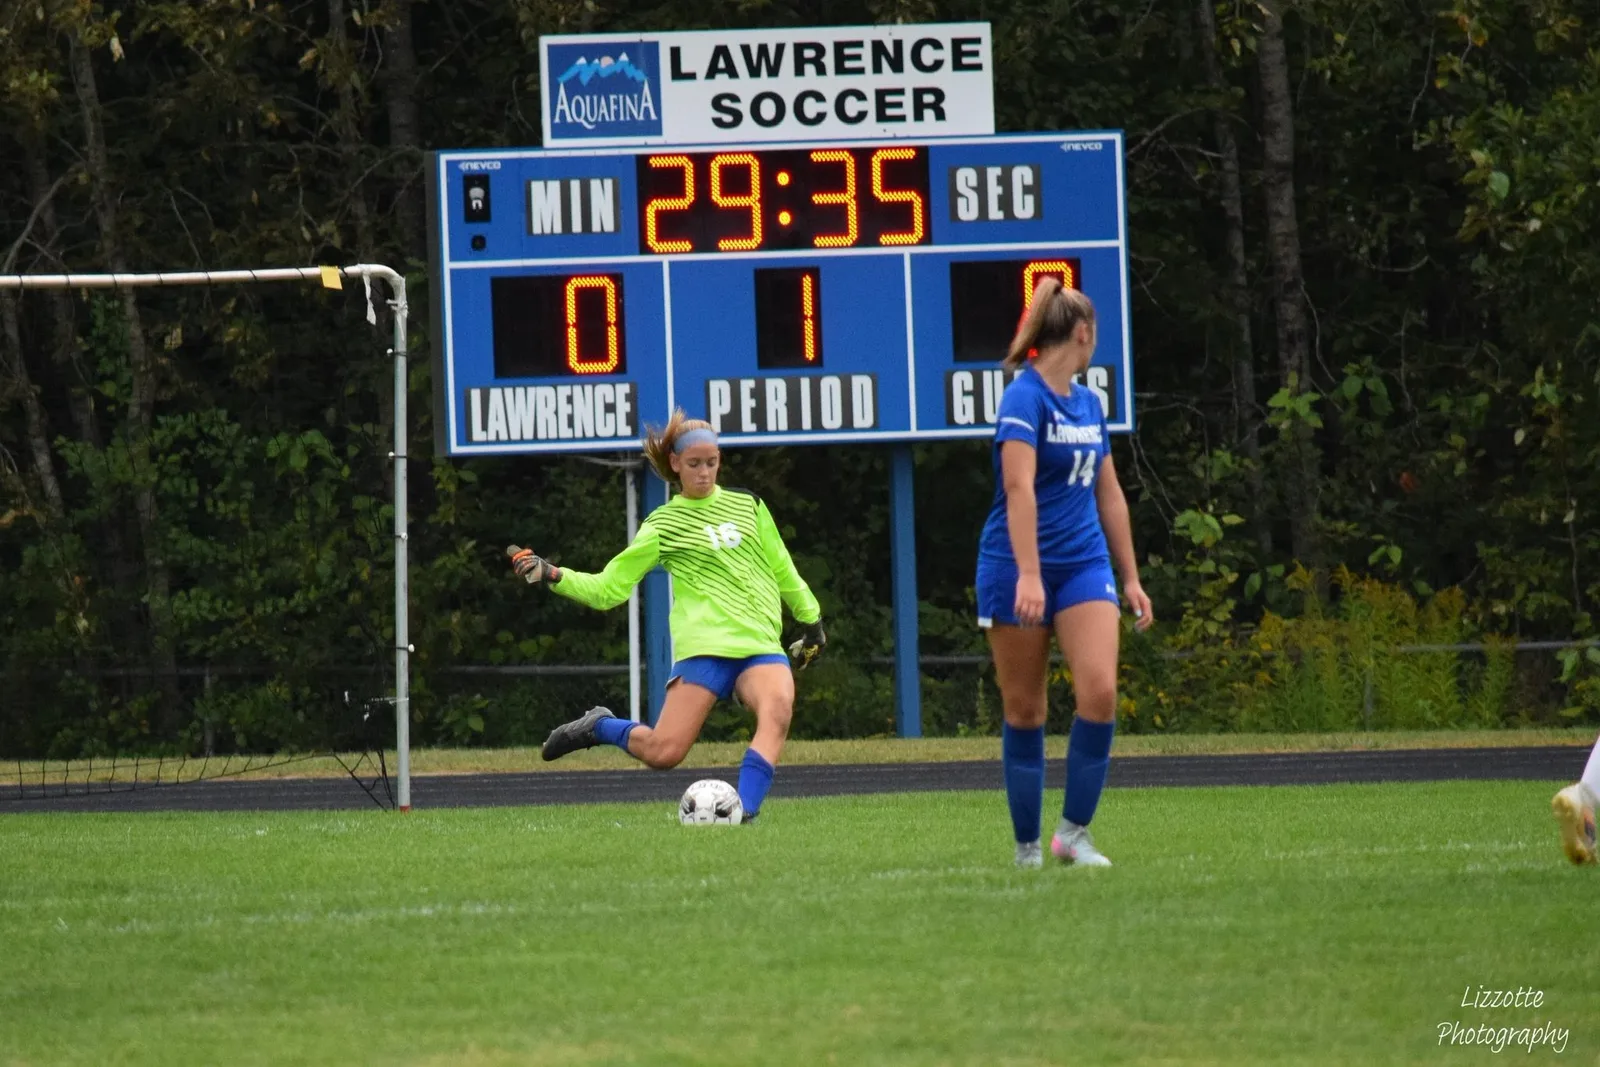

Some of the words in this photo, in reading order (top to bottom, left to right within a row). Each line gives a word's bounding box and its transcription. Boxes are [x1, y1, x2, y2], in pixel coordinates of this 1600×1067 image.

[669, 36, 983, 81] LAWRENCE
[553, 78, 658, 130] AQUAFINA
[710, 86, 946, 130] SOCCER
[530, 177, 615, 235] MIN
[646, 147, 924, 254] 29:35
[955, 165, 1036, 222] SEC
[565, 275, 618, 374] 0
[802, 273, 815, 362] 1
[470, 382, 633, 442] LAWRENCE
[708, 374, 875, 433] PERIOD
[952, 366, 1109, 426] GUS
[1067, 449, 1097, 488] 14
[703, 521, 743, 551] 16
